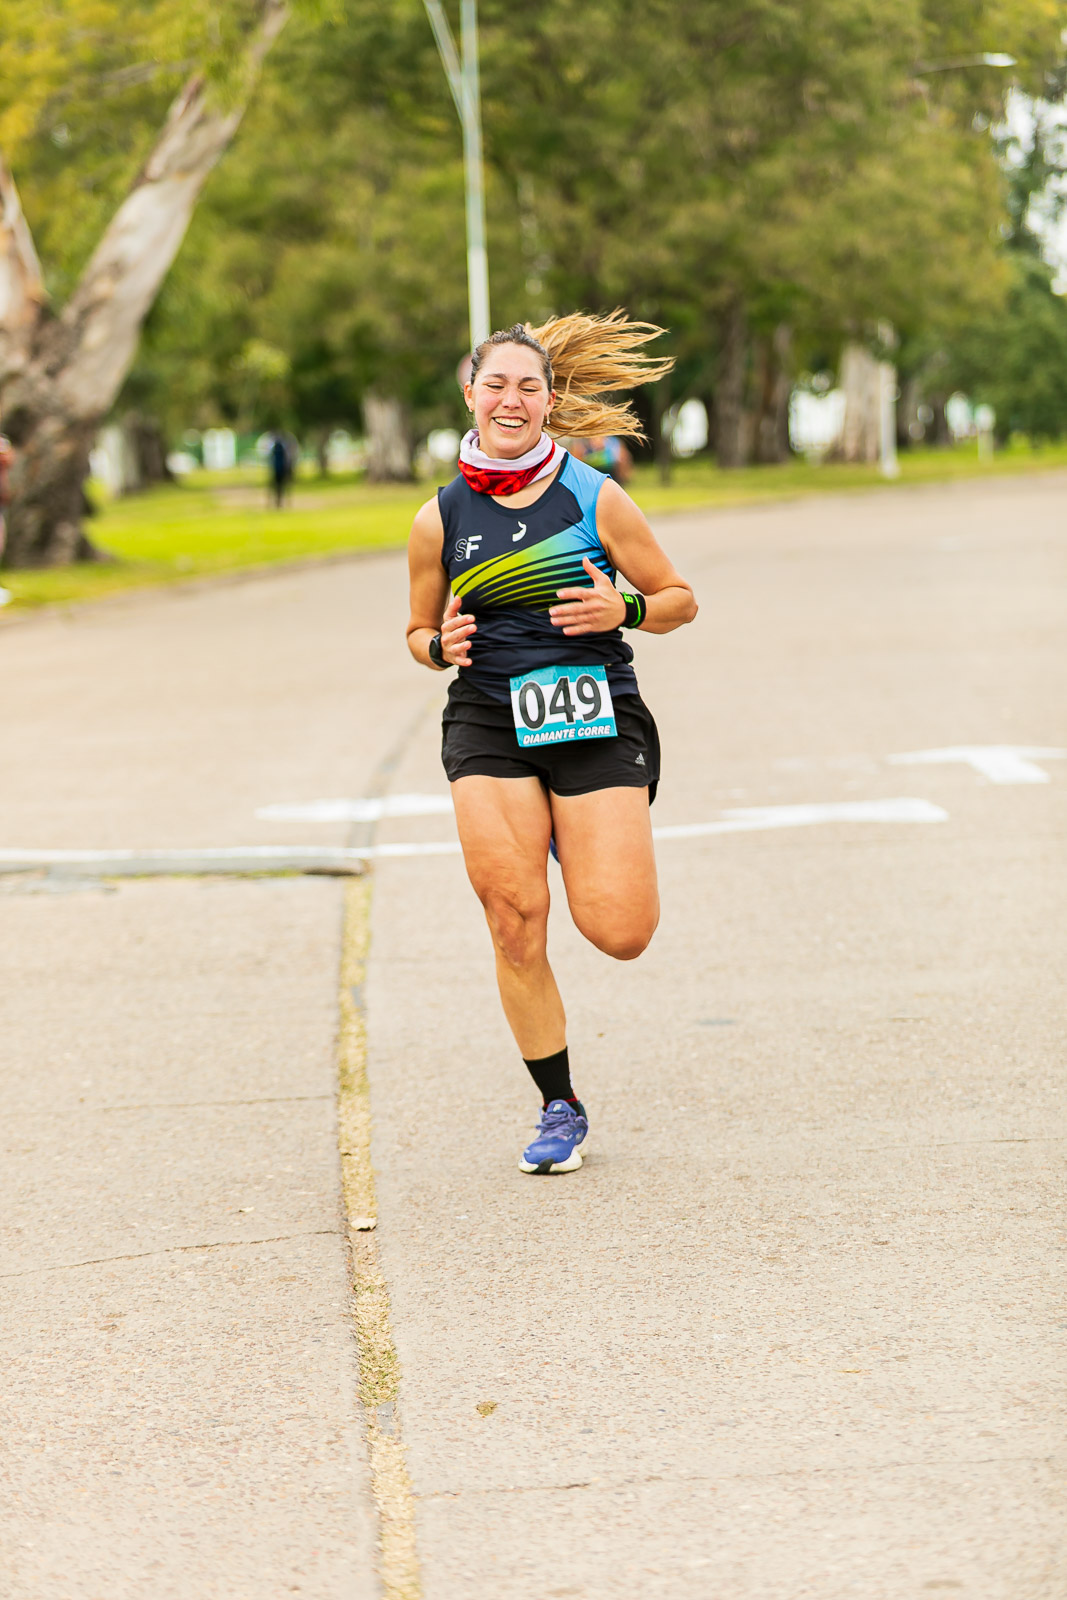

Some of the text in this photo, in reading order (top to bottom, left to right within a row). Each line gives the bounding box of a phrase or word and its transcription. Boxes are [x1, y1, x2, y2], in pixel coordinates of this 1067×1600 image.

[454, 535, 482, 562] SF
[518, 674, 602, 730] 049
[523, 725, 611, 745] DIAMANTE CORRE
